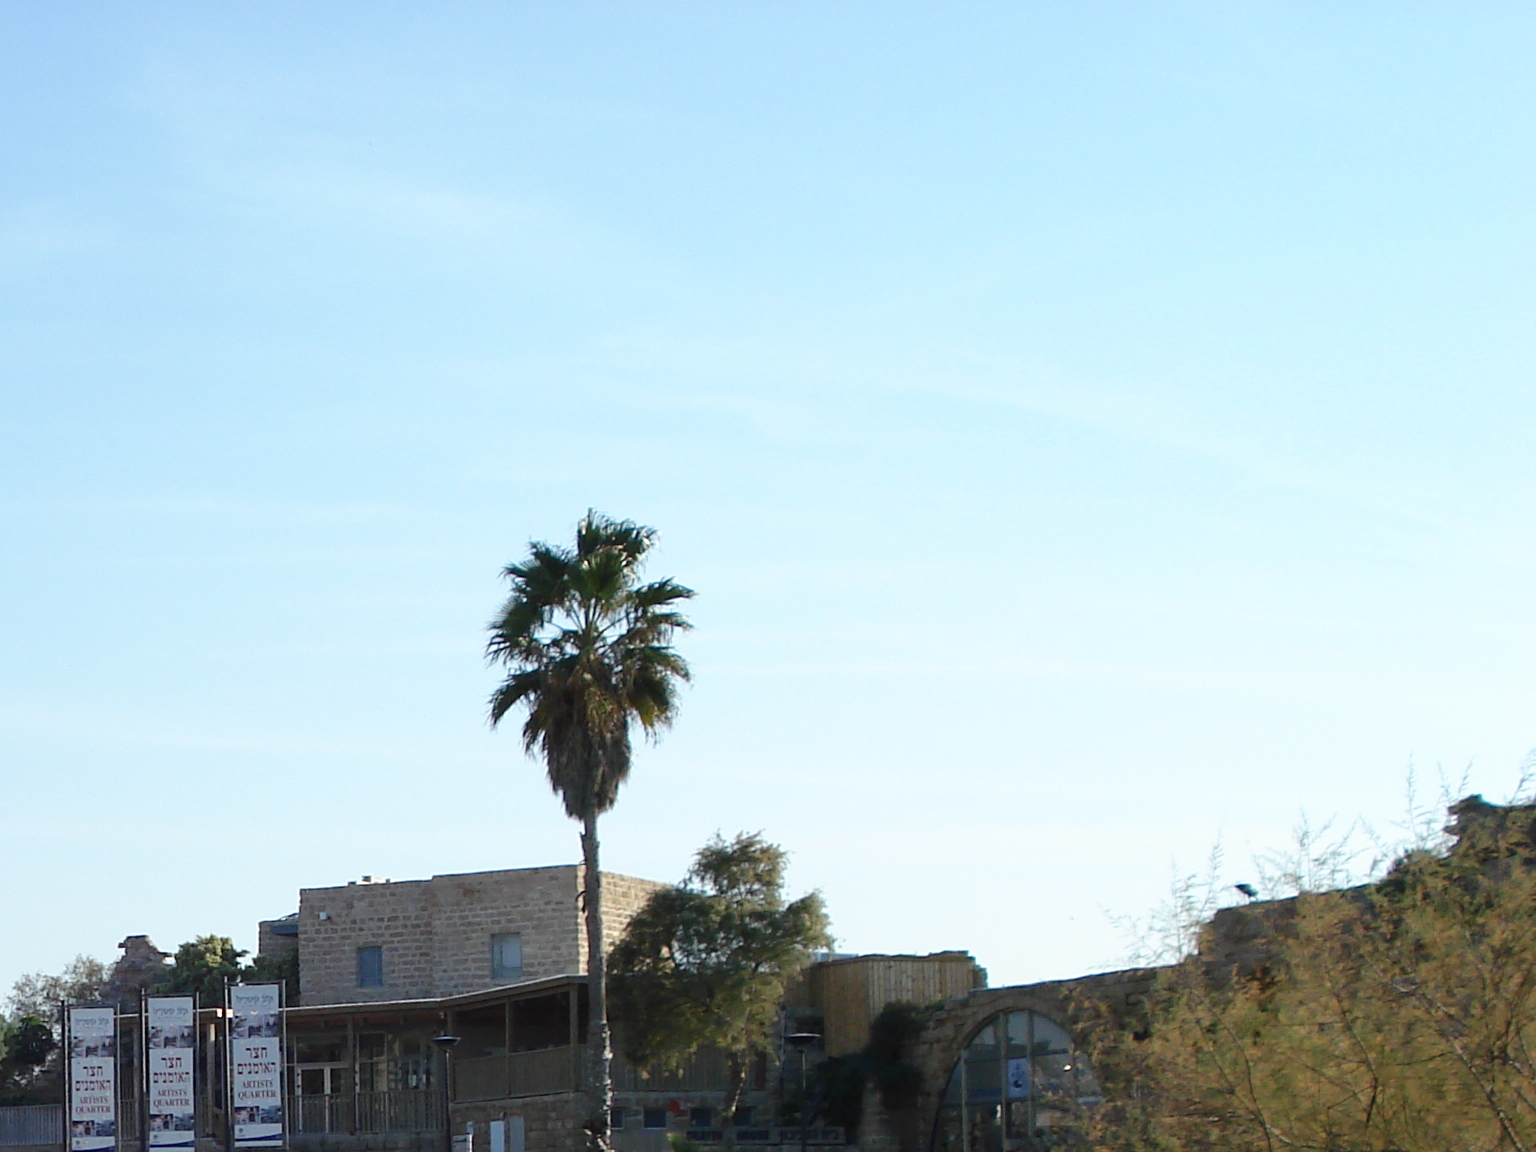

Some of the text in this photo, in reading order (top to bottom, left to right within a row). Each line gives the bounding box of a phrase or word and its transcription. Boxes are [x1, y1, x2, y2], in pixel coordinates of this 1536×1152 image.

[245, 1047, 267, 1059] חצר
[161, 1057, 182, 1069] חצר
[82, 1066, 103, 1077] חצר
[237, 1062, 276, 1075] האומנים
[153, 1071, 190, 1083] האומנים
[75, 1080, 111, 1091] האומנים
[242, 1079, 273, 1088] ARTISTS
[156, 1088, 187, 1097] ARTISTS
[238, 1090, 276, 1100] QUARTER
[79, 1096, 108, 1105] ARTISTS
[153, 1098, 190, 1108] QUARTER
[75, 1106, 111, 1114] QUARTER
